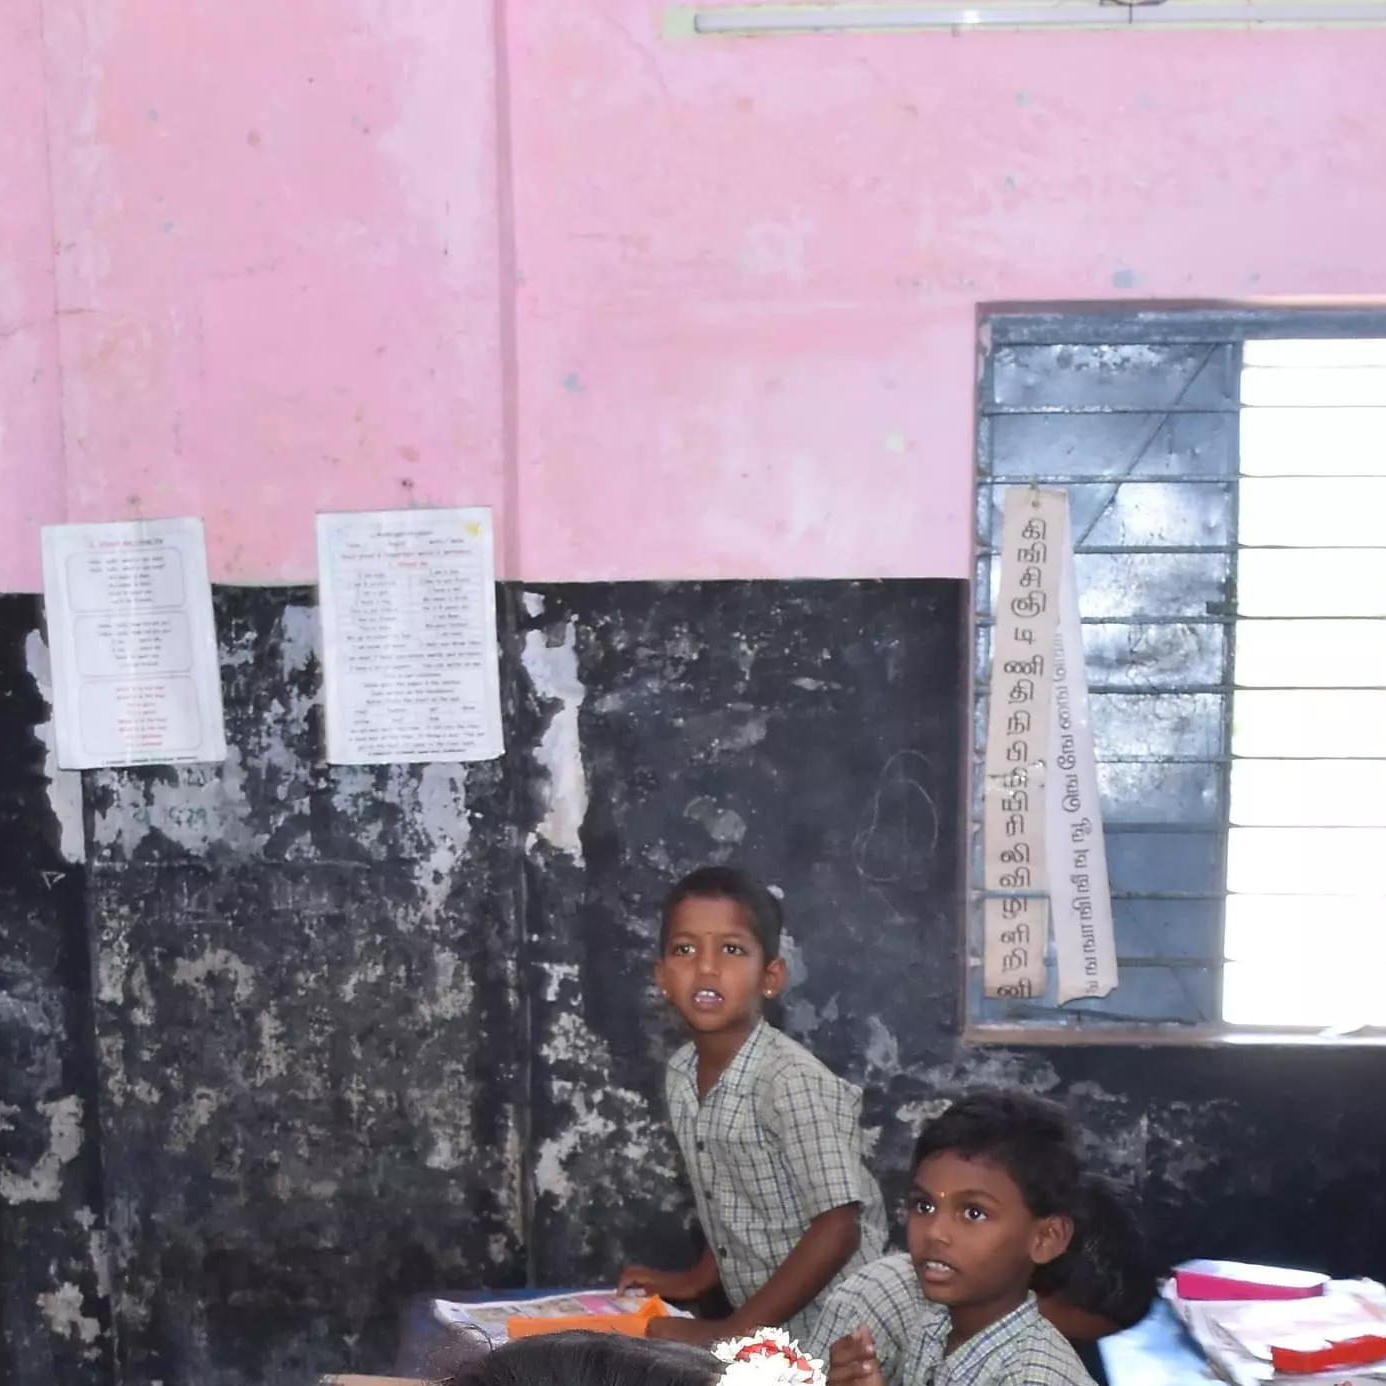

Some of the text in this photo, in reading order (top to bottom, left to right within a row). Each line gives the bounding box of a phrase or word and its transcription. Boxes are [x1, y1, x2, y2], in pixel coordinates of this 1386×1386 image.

[1022, 518, 1046, 540] கி
[1017, 542, 1047, 564] ஙி
[1019, 566, 1041, 588] சி
[1011, 589, 1047, 617] ஞி
[1003, 654, 1045, 677] ணி
[1008, 680, 1034, 704] தி
[1007, 711, 1031, 735] நி
[1006, 740, 1029, 761] பி
[1057, 735, 1077, 770] ஙே
[1001, 791, 1028, 812] யி
[1062, 774, 1082, 812] ஙெ
[1000, 841, 1031, 864] லி
[998, 866, 1031, 888] வி
[1000, 924, 1030, 945] ளி
[1002, 949, 1029, 971] றி
